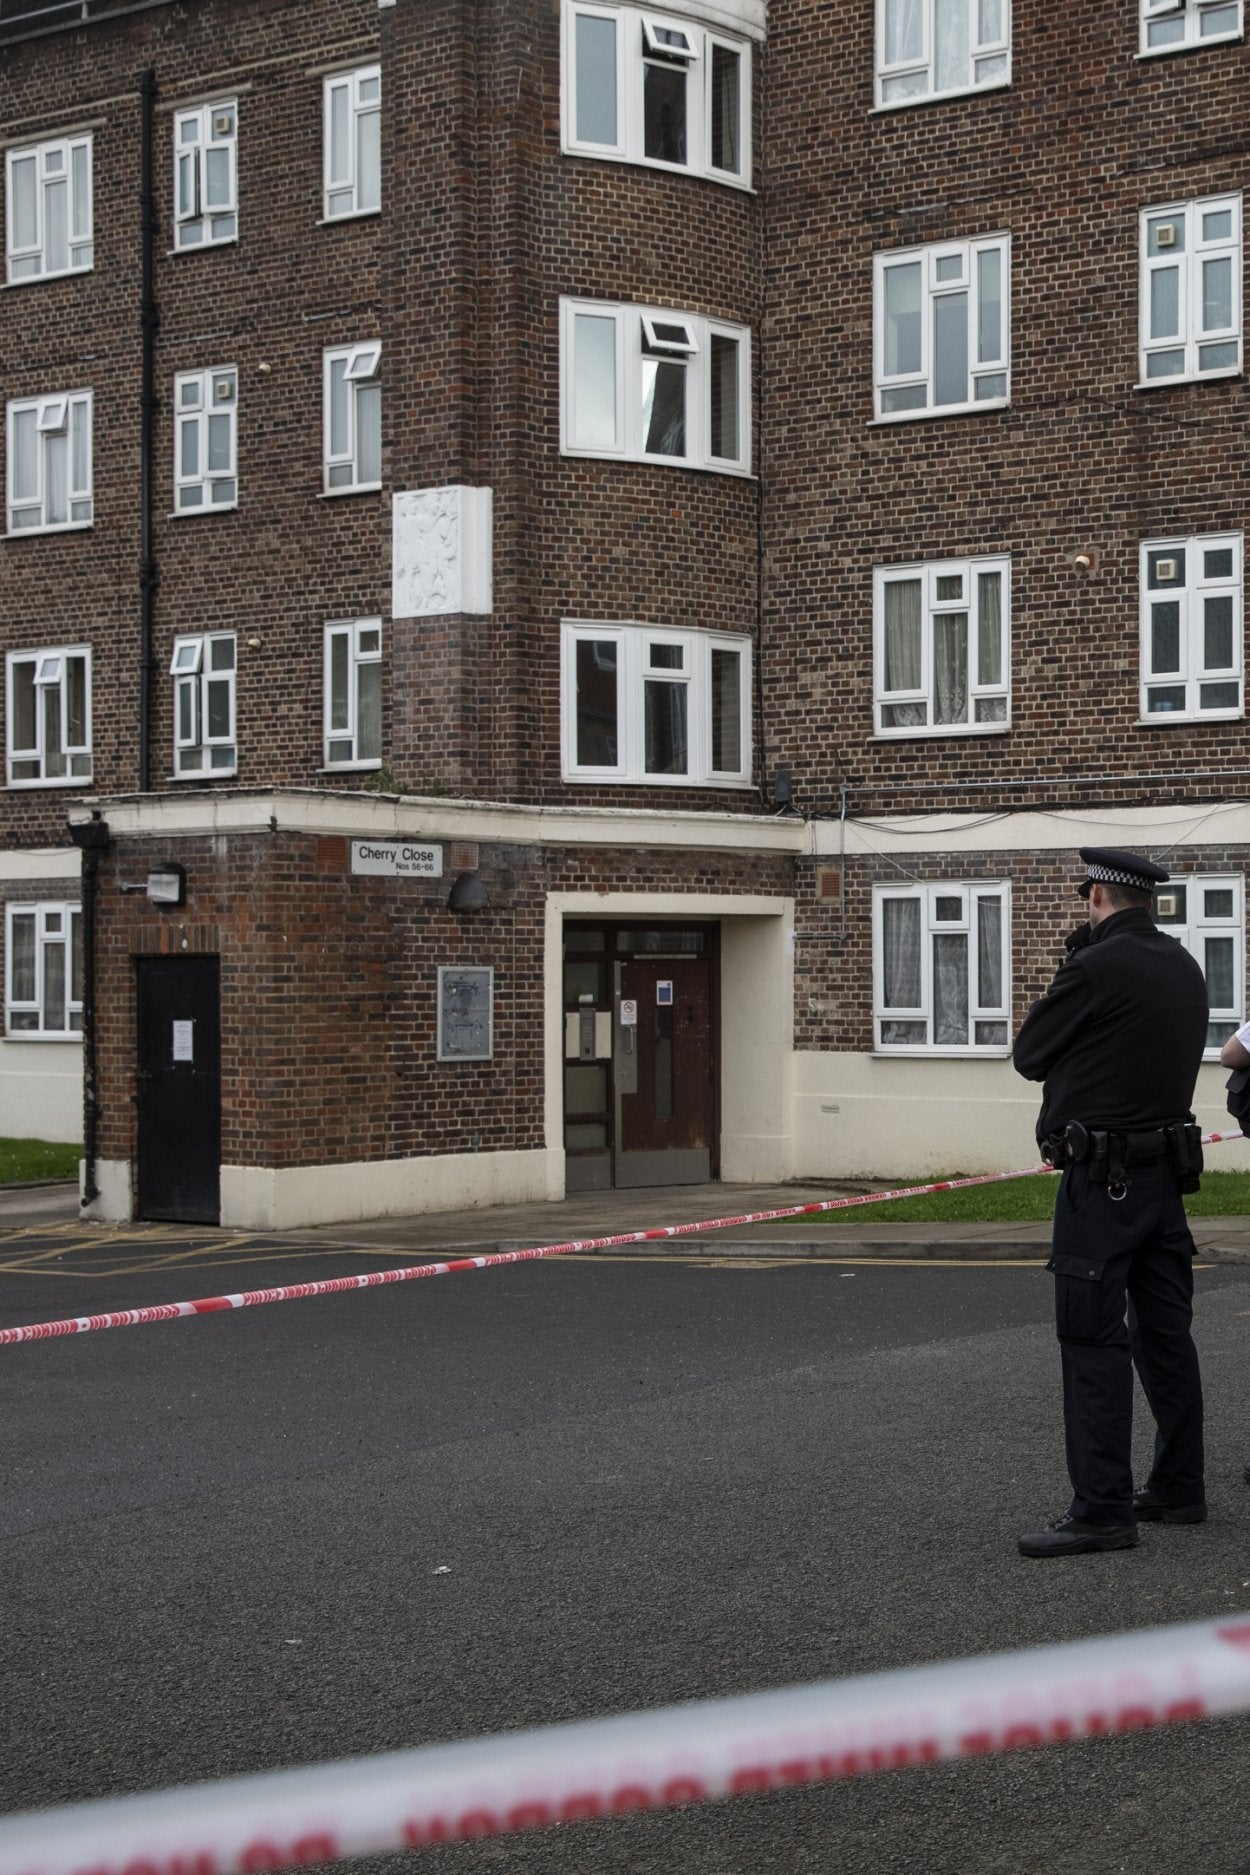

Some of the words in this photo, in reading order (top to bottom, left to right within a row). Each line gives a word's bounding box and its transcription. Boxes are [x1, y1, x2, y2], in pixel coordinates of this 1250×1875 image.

[359, 846, 397, 863] Cherry
[402, 847, 434, 861] Close
[395, 862, 410, 870] Nos
